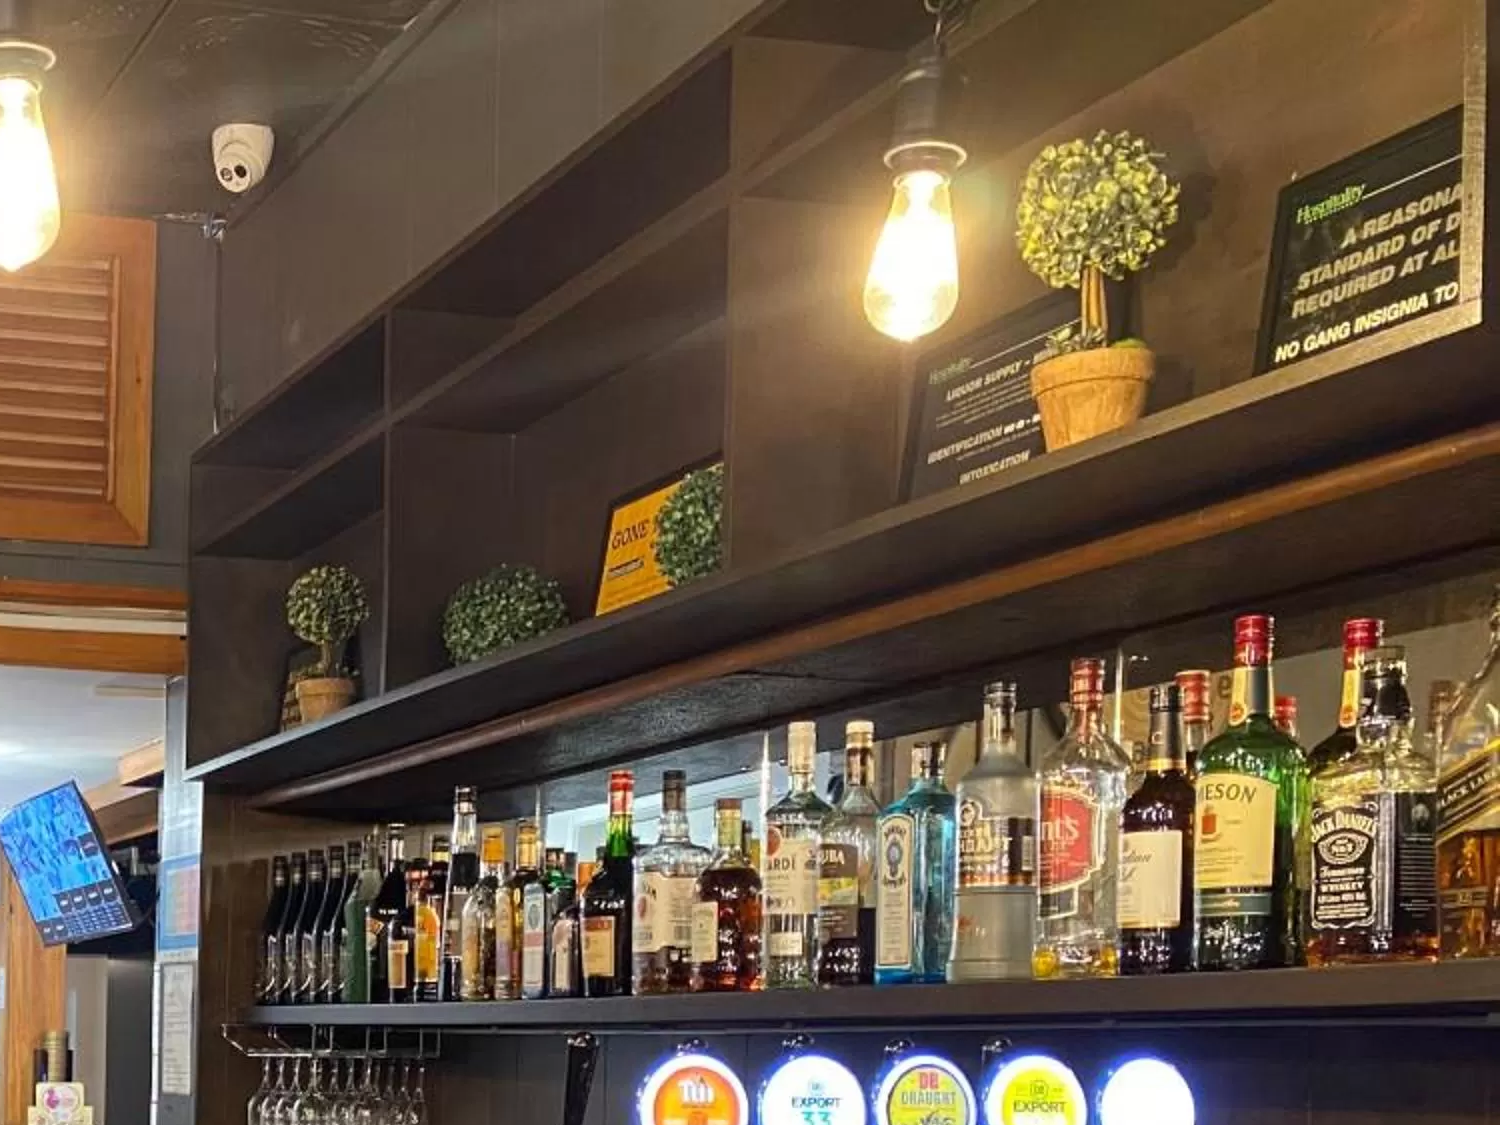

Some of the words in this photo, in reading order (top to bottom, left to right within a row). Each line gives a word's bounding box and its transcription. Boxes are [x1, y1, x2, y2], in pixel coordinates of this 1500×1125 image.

[1341, 228, 1357, 249] A
[1297, 235, 1404, 290] STANDARD
[1411, 220, 1440, 246] OF
[1292, 266, 1396, 319] REQUIRED
[1400, 251, 1428, 277] AT
[1275, 343, 1299, 363] NO
[1303, 321, 1350, 353] GANG
[1354, 293, 1428, 333] INSIGNIA
[1434, 282, 1459, 304] TO
[984, 361, 1023, 386] SUPPLY
[611, 519, 650, 550] GONE
[919, 1071, 940, 1089] DB
[791, 1097, 843, 1109] EXPORT
[900, 1091, 956, 1105] DRAUGHT
[1013, 1099, 1068, 1113] EXPORT
